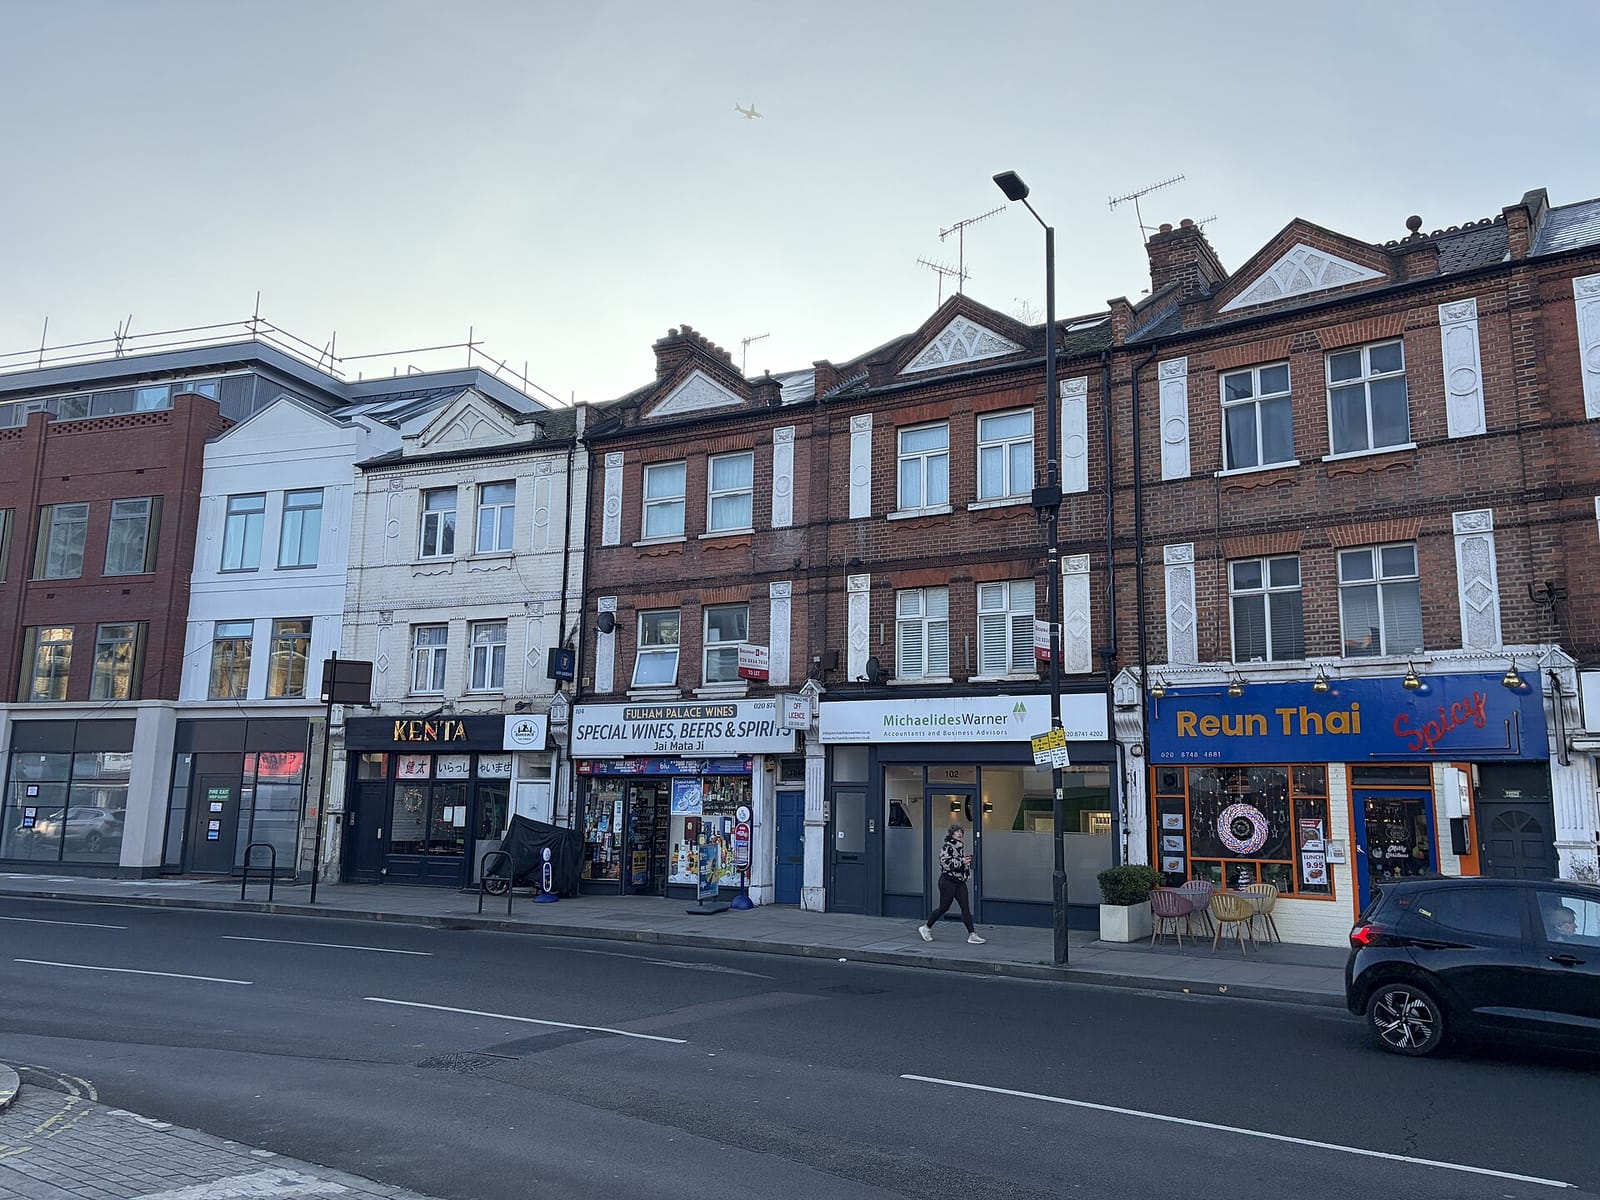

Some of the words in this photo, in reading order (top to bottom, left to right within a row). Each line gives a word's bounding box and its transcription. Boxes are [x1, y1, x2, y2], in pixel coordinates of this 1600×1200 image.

[626, 709, 662, 719] FULHAM
[666, 707, 701, 718] PALACE
[705, 706, 734, 717] WINES
[1176, 711, 1268, 737] Reun
[1275, 702, 1361, 735] Thai
[883, 713, 1008, 727] MichaelidesWarner
[1393, 691, 1487, 757] Spicy
[393, 720, 468, 741] KENTA
[576, 724, 628, 740] SPECIAL
[632, 723, 676, 741] WINES,
[680, 722, 722, 738] BEERS
[725, 721, 735, 738] &
[653, 741, 667, 751] Jai
[670, 741, 693, 751] Mata
[696, 741, 704, 750] Ji
[945, 770, 959, 778] 102
[1306, 861, 1324, 869] 9.95
